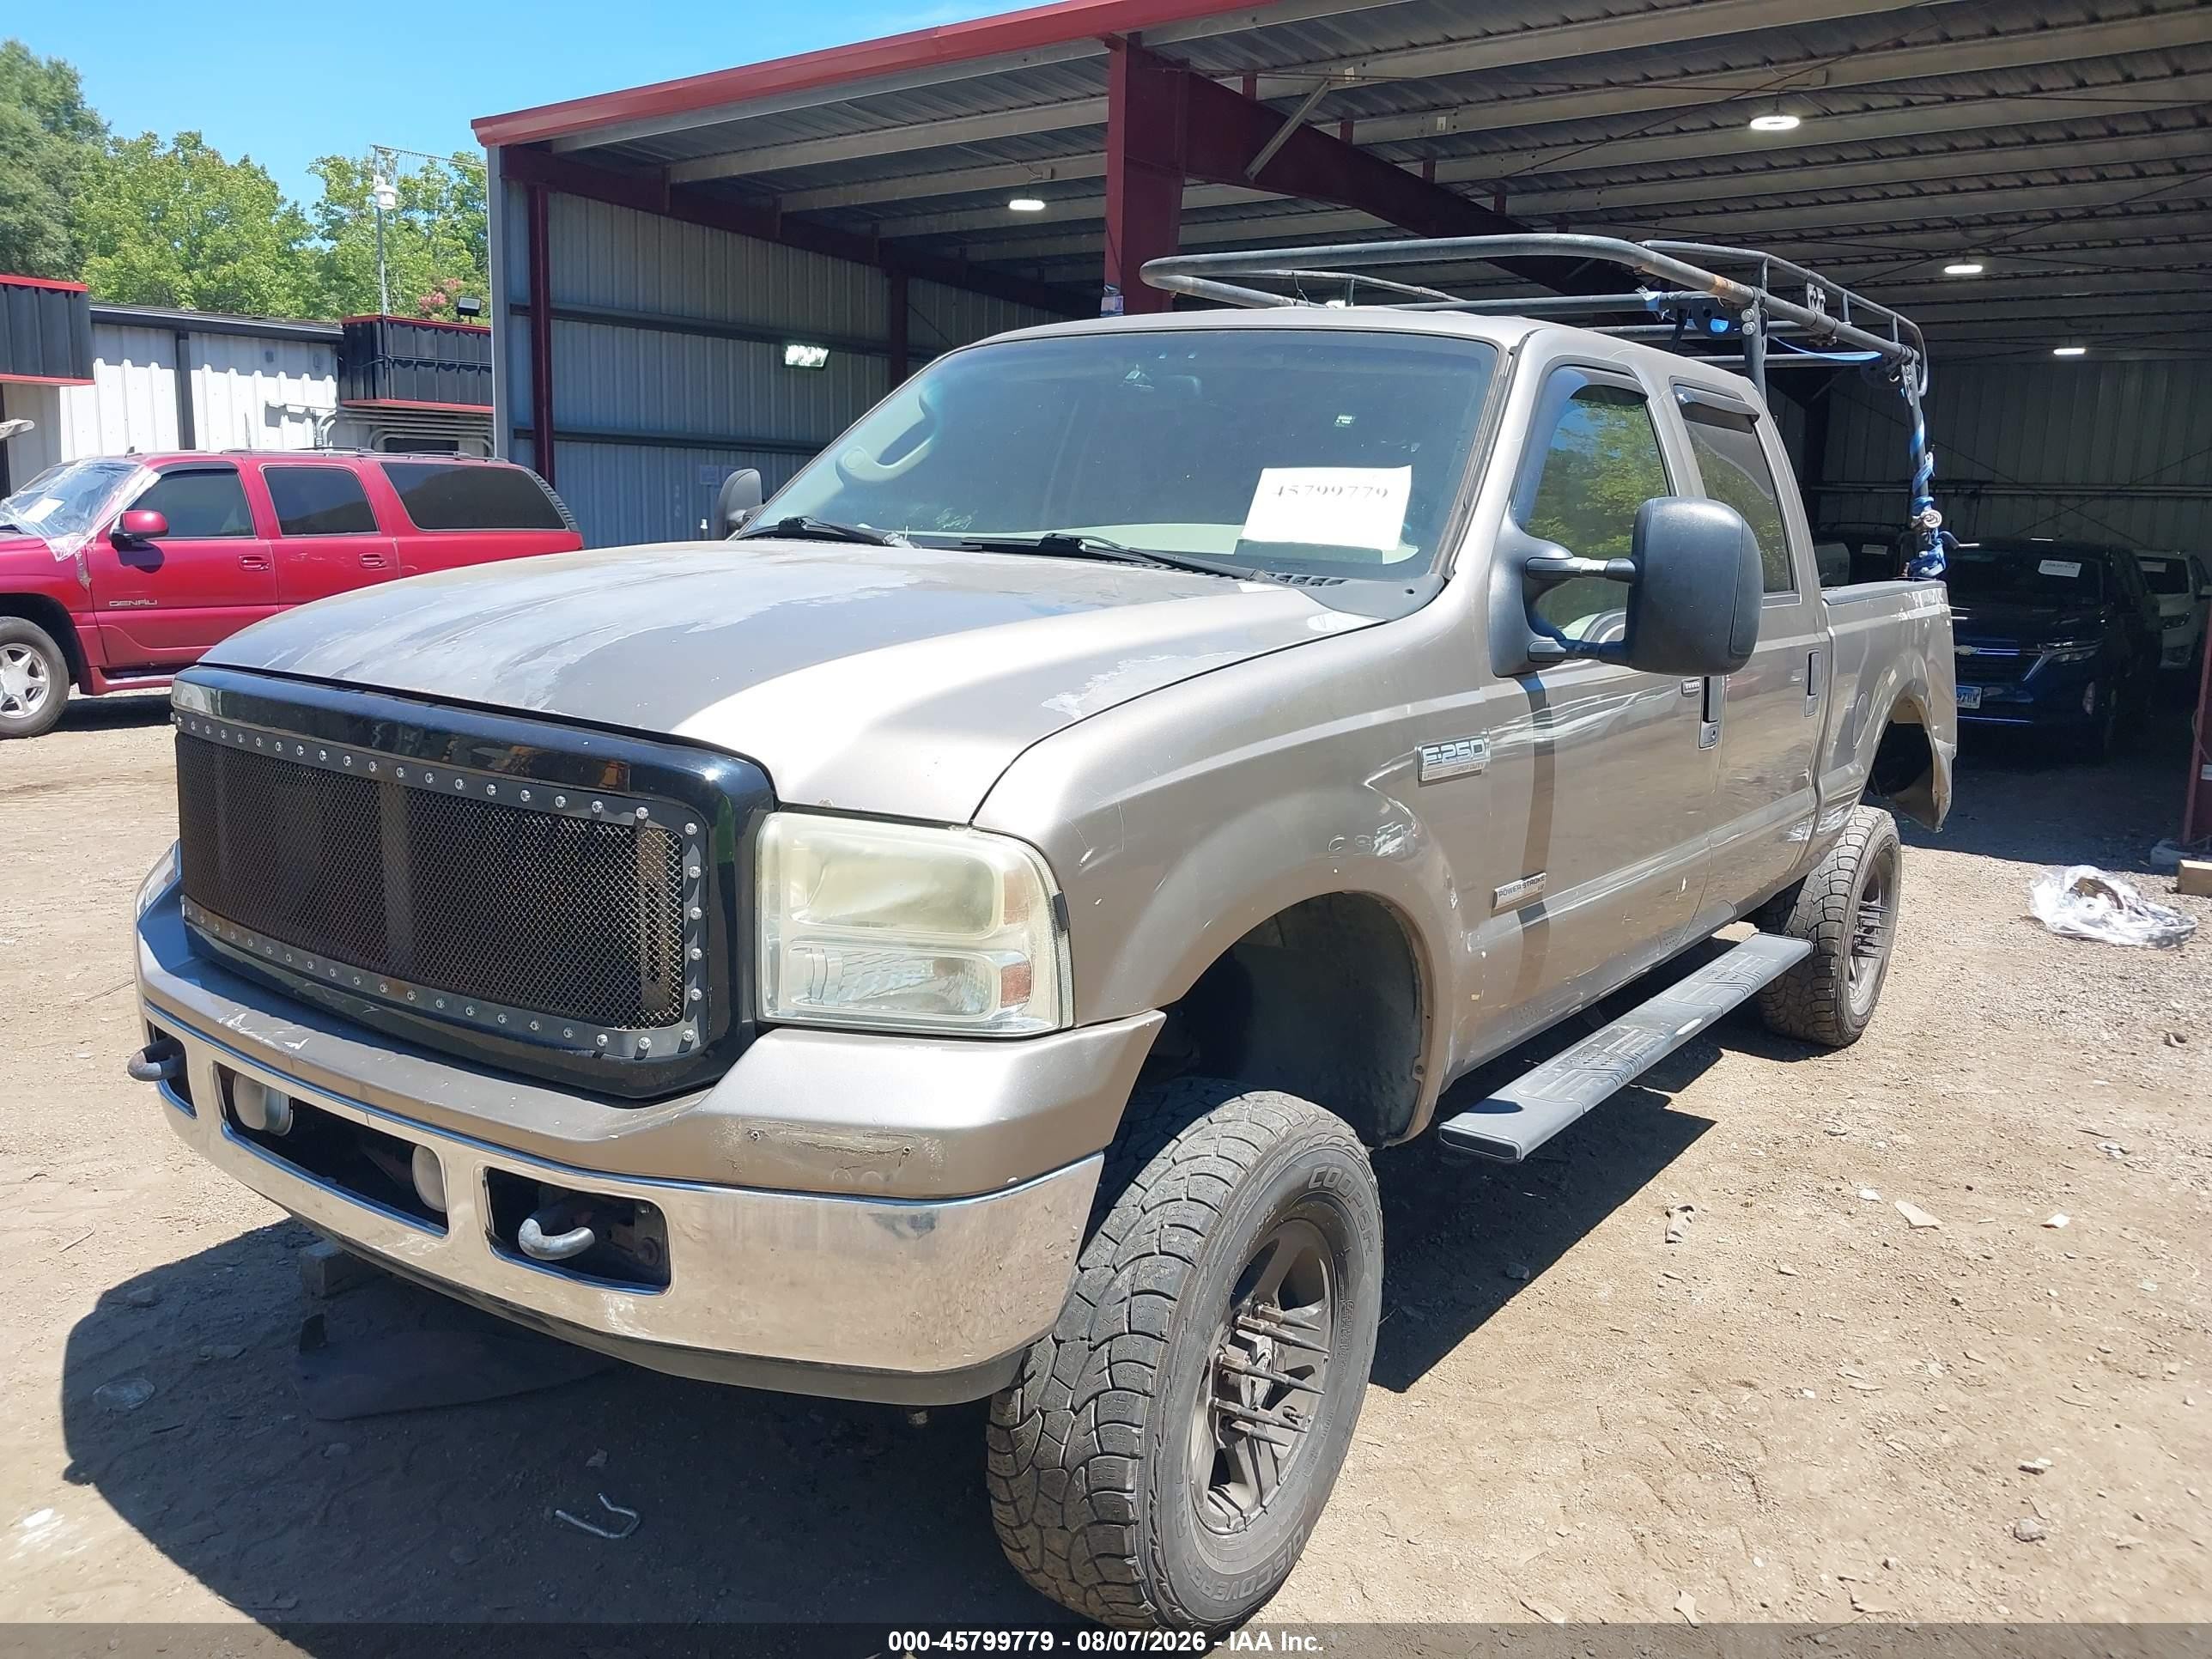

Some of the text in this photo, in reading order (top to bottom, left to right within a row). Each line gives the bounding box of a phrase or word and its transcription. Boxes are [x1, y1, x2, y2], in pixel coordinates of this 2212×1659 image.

[1271, 483, 1389, 499] 45799779
[108, 599, 158, 608] DENALI
[1498, 874, 1547, 898] POWER STROKE
[1308, 1165, 1375, 1256] COOPER
[1182, 1524, 1304, 1601] DISCOVERER
